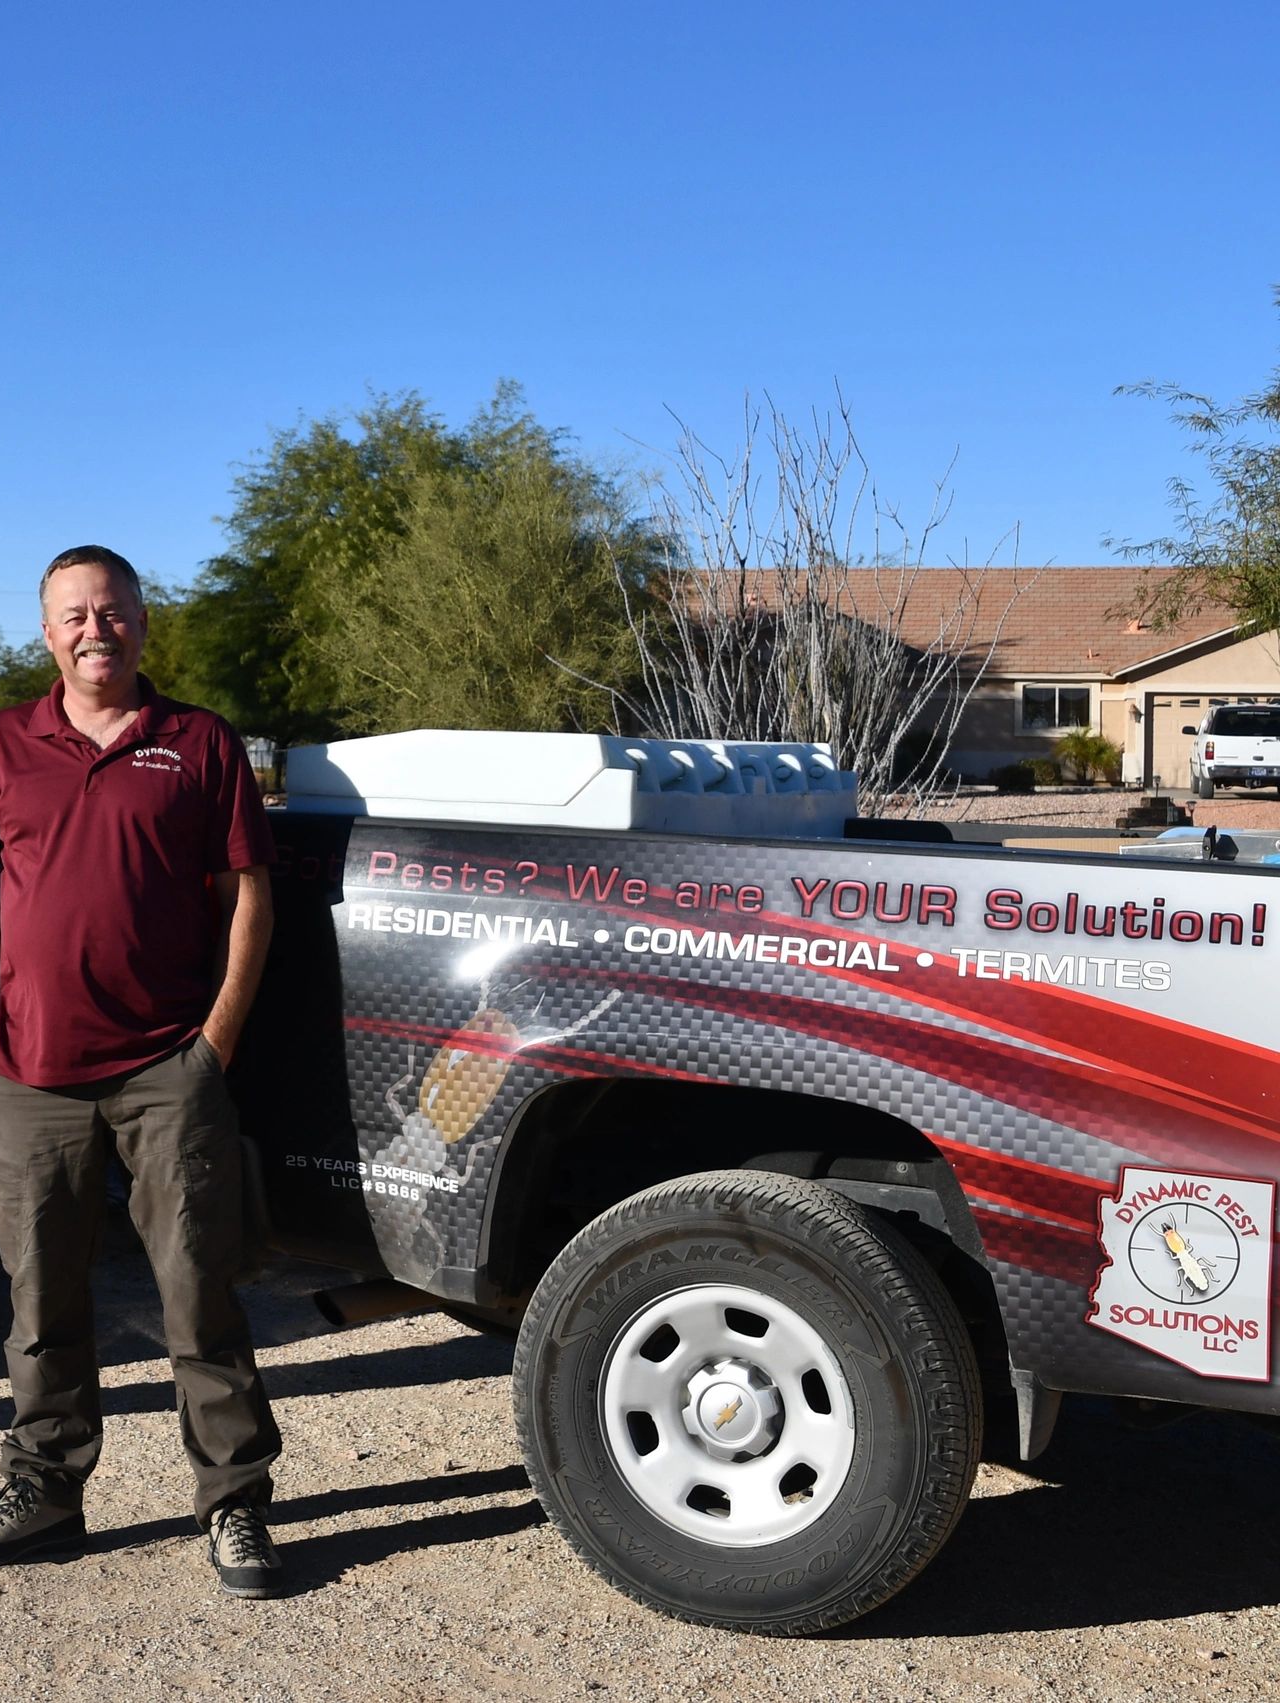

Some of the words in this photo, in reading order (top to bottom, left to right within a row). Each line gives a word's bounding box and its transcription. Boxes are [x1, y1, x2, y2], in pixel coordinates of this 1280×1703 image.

[134, 747, 182, 761] Dynamic
[366, 850, 540, 897] Pests?
[565, 863, 649, 905] We
[675, 881, 766, 914] are
[791, 876, 958, 927] YOUR
[983, 887, 1268, 948] Solution!
[347, 904, 579, 949] RESIDENTIAL
[623, 926, 900, 973] COMMERCIAL
[950, 947, 1173, 992] TERMITES
[285, 1154, 308, 1168] 25
[313, 1157, 368, 1175] YEARS
[371, 1164, 459, 1194] EXPERIENCE
[330, 1175, 420, 1202] LIC#8866
[1115, 1179, 1212, 1224] DYNAMIC
[1214, 1193, 1260, 1238] PEST
[582, 1245, 852, 1330] WRANGLER
[1109, 1304, 1259, 1341] SOLUTIONS
[1202, 1335, 1238, 1354] LLC
[584, 1498, 863, 1595] GOODYEAR
